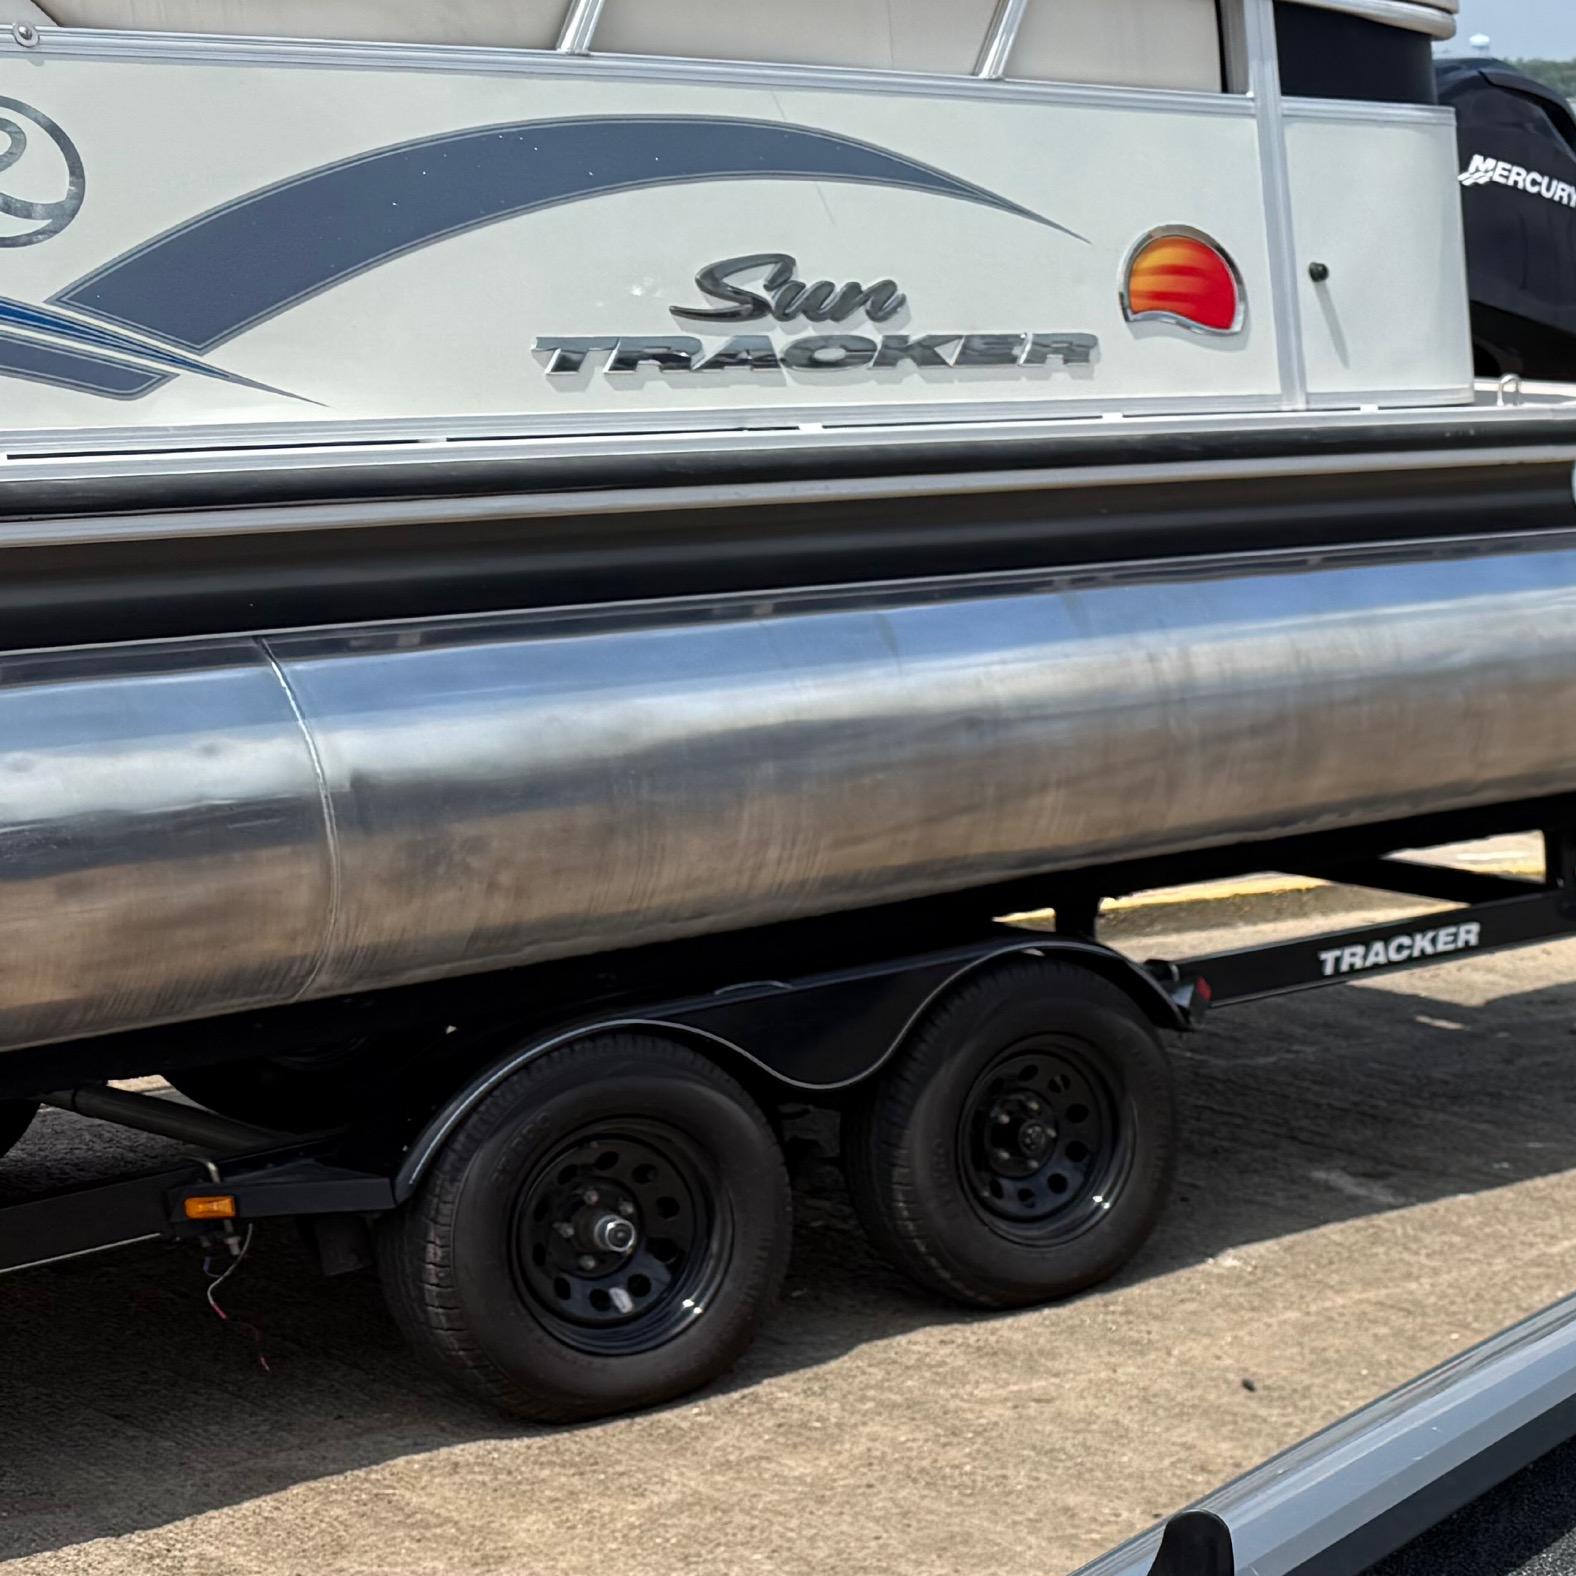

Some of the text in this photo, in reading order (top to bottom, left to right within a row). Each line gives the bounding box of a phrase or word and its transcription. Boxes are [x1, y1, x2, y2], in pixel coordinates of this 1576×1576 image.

[669, 253, 907, 322] Sun
[530, 332, 1099, 375] TRACKER
[1319, 922, 1481, 976] TRACKER
